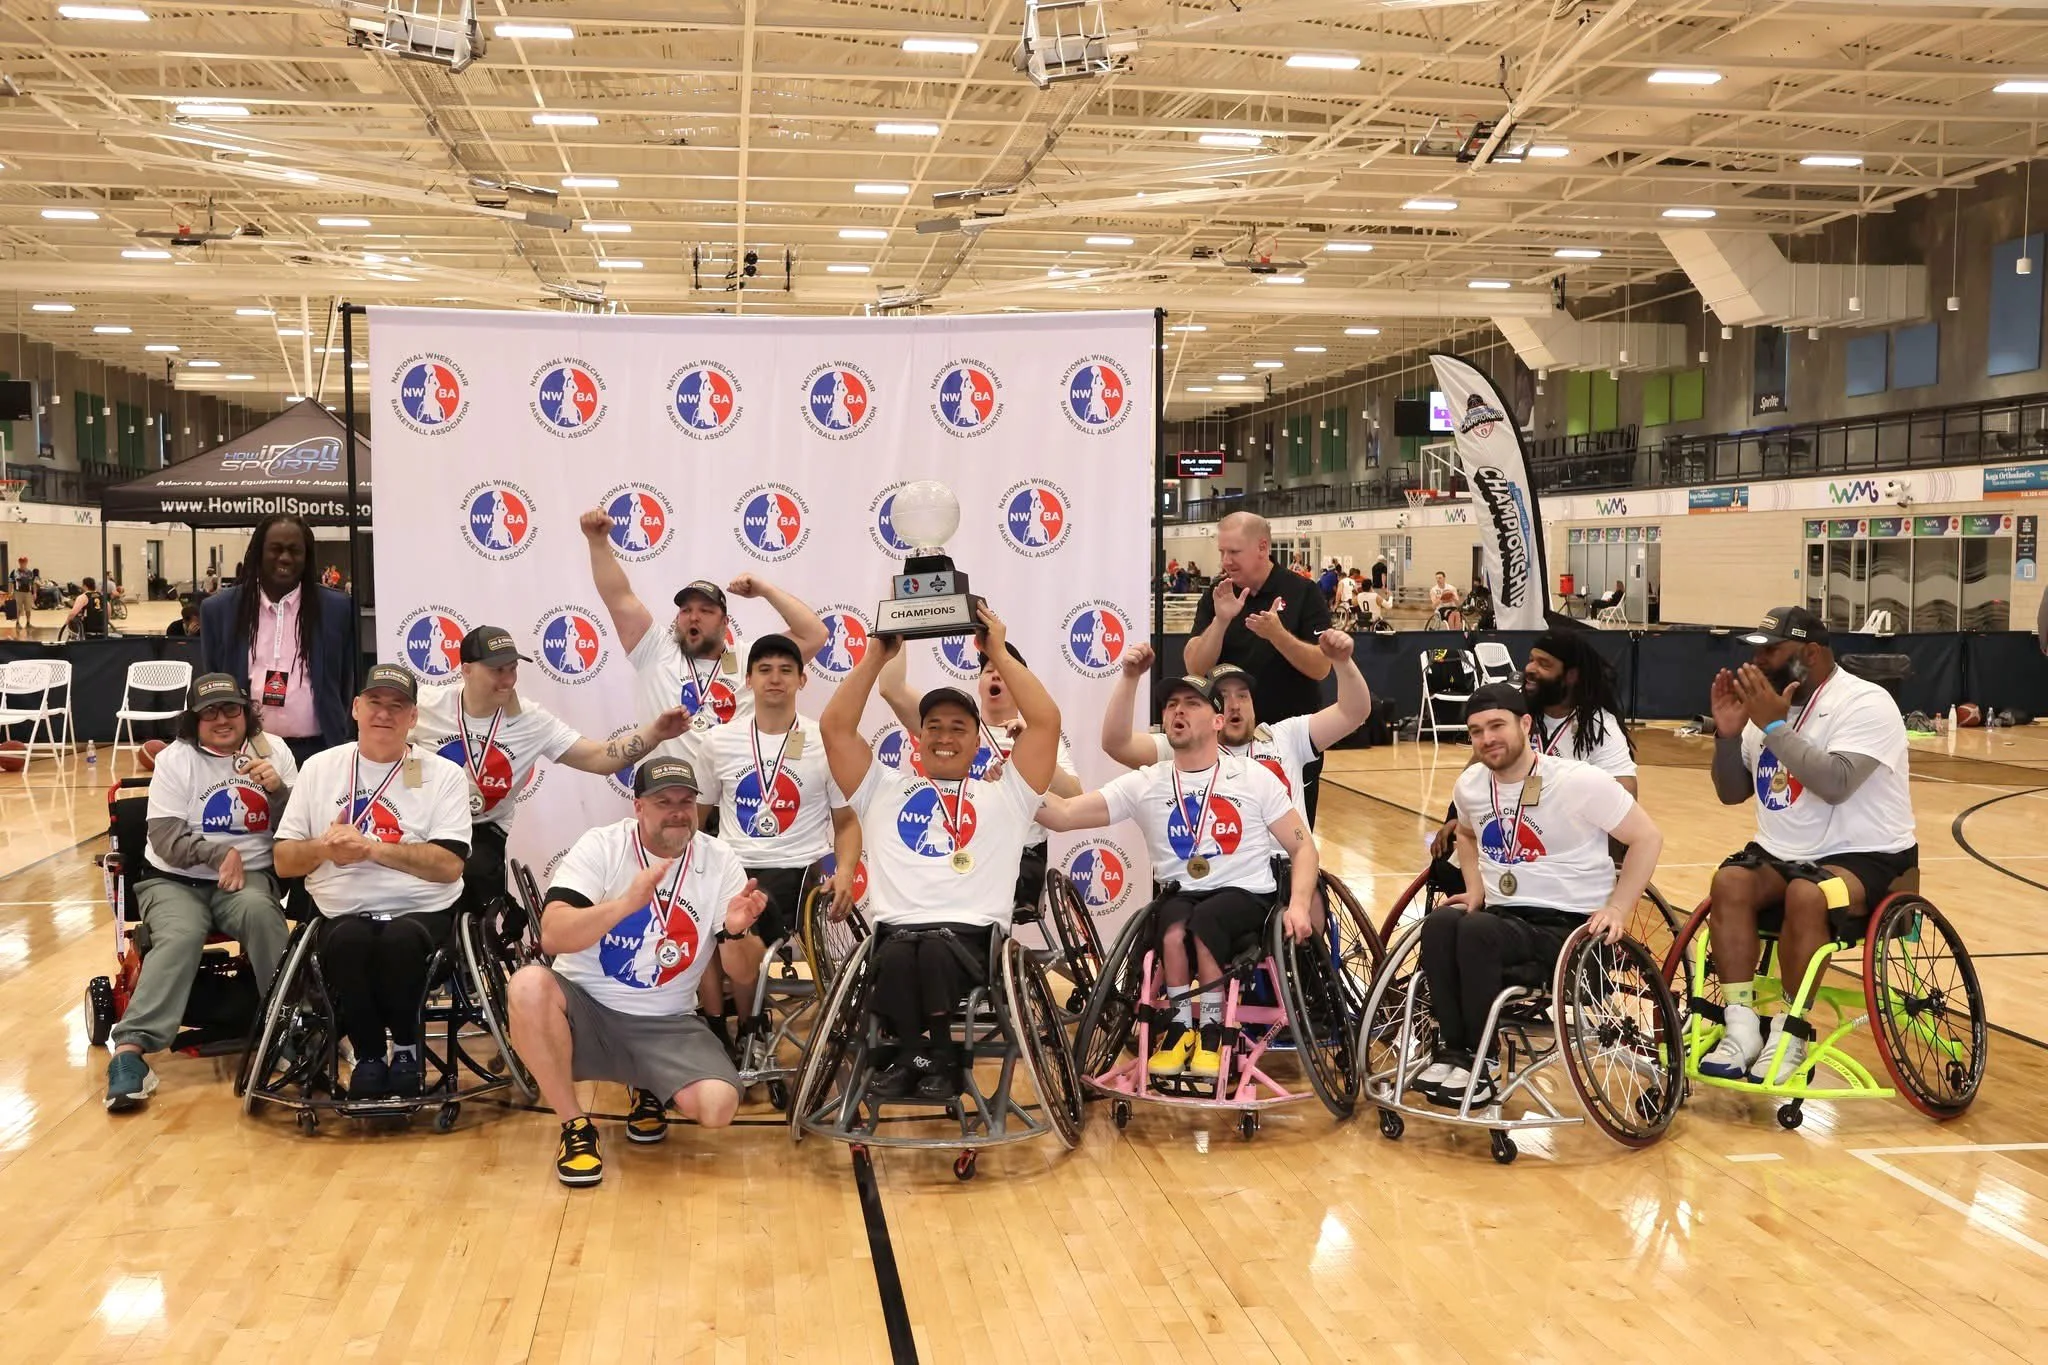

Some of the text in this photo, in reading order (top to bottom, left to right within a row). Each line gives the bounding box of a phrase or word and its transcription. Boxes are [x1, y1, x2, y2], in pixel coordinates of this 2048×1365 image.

[391, 352, 469, 387] NATIONAL WHEELCHAIR
[529, 357, 606, 391] NATIONAL WHEELCHAIR
[667, 360, 742, 393] NATIONAL WHEELCHAIR
[801, 360, 875, 393] NATIONAL WHEELCHAIR
[930, 358, 1002, 390] NATIONAL WHEELCHAIR
[1060, 355, 1131, 386] NATIONAL WHEELCHAIR
[404, 388, 456, 398] NW BA
[542, 392, 594, 402] NW BA
[679, 394, 730, 403] NW BA
[813, 395, 864, 404] NW BA
[942, 392, 991, 401] NW BA
[1072, 389, 1120, 398] NW BA
[391, 398, 470, 436] BASKETBALL ASSOCIATION
[529, 401, 608, 438] BASKETBALL ASSOCIATION
[666, 404, 743, 440] BASKETBALL ASSOCIATION
[800, 405, 877, 440] BASKETBALL ASSOCIATION
[930, 402, 1004, 438] BASKETBALL ASSOCIATION
[1060, 399, 1133, 435] BASKETBALL ASSOCIATION
[219, 460, 339, 471] SPORTS
[461, 479, 536, 513] NATIONAL WHEELCHAIR
[600, 482, 673, 515] ATIONAL WHEELCHAIR
[734, 482, 809, 514] NATIONAL WHEELCHAIR
[869, 482, 899, 512] NATIONAL
[998, 478, 1071, 509] NATIONAL WHEELCHAIR
[472, 515, 524, 524] NW BA
[644, 517, 661, 526] BA
[746, 517, 797, 526] NW BA
[881, 516, 891, 525] N
[1010, 512, 1060, 521] NW BA
[460, 525, 538, 561] BASKETBALL ASSOCIATION
[612, 527, 675, 562] TBALL ASSOCIATION
[734, 527, 811, 562] BASKETBALL ASSOCIATION
[869, 526, 902, 560] BASKETBALL
[998, 522, 1072, 558] BASKETBALL ASSOCIATION
[1475, 466, 1528, 608] CHAMPIONSHIP
[533, 604, 607, 637] NATIONAL WHEELCHAIR
[835, 604, 874, 632] WHEELCHAI
[891, 606, 956, 619] CHAMPIONS
[1061, 600, 1133, 631] NATIONAL WHEELCHAIR
[1363, 600, 1369, 612] 0
[396, 605, 472, 637] NATIONAL WHEELCHAI
[409, 640, 460, 649] NW BA
[545, 639, 596, 648] NW BA
[847, 638, 864, 647] BA
[944, 636, 963, 644] NW
[1072, 633, 1121, 643] NW BA
[533, 650, 609, 685] BASKETBALL ASSOCIATION
[808, 662, 838, 682] KETBALL
[932, 646, 967, 680] BASKETBALL
[1061, 644, 1095, 678] BASKETBALL
[871, 721, 899, 749] NATIONAL
[881, 753, 920, 762] NW B
[972, 764, 986, 775] W
[483, 776, 508, 788] BA
[514, 769, 545, 803] SSOCIATION
[1758, 766, 1777, 779] NW
[199, 777, 266, 802] National Champion
[736, 796, 795, 809] NW BA
[204, 811, 266, 826] NW BA
[900, 811, 973, 824] NW A
[1215, 822, 1238, 835] BA
[543, 847, 572, 878] NATIONA
[1060, 838, 1132, 870] NATIONAL WHEELCHAIR
[1072, 872, 1120, 880] NW BA
[1096, 883, 1133, 917] ASSOCIATION
[605, 933, 640, 950] NW
